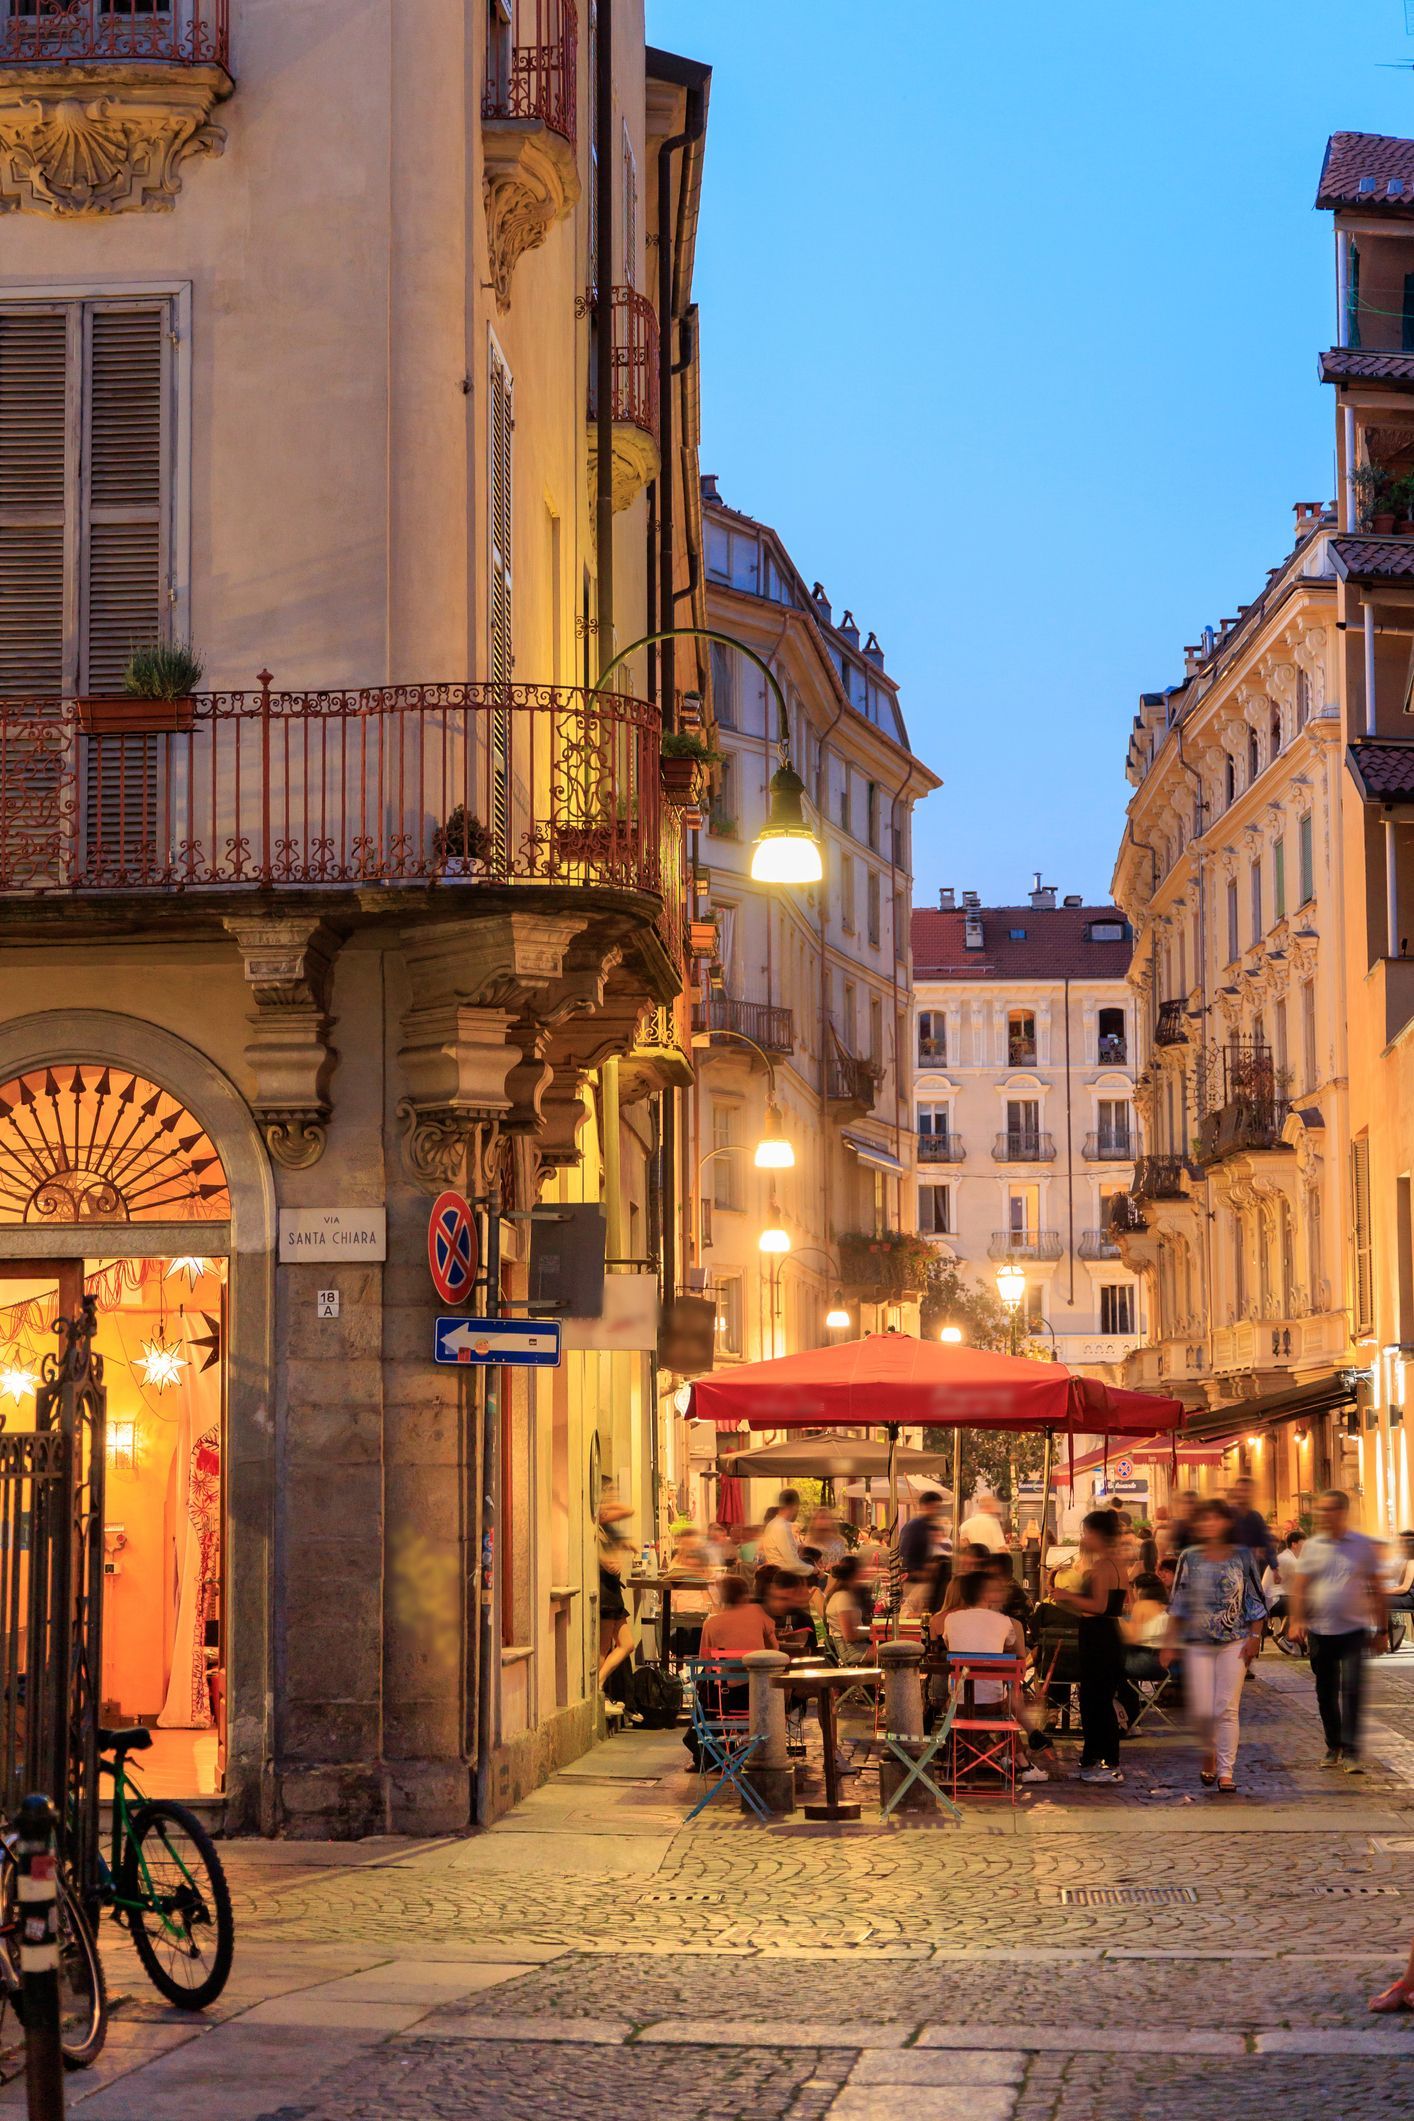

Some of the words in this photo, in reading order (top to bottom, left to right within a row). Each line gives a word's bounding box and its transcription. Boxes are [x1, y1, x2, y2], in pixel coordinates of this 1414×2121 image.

[323, 1216, 340, 1224] VIA
[288, 1231, 326, 1245] SANTA
[332, 1231, 377, 1244] CHIARA
[320, 1292, 335, 1303] 18
[323, 1305, 333, 1316] A
